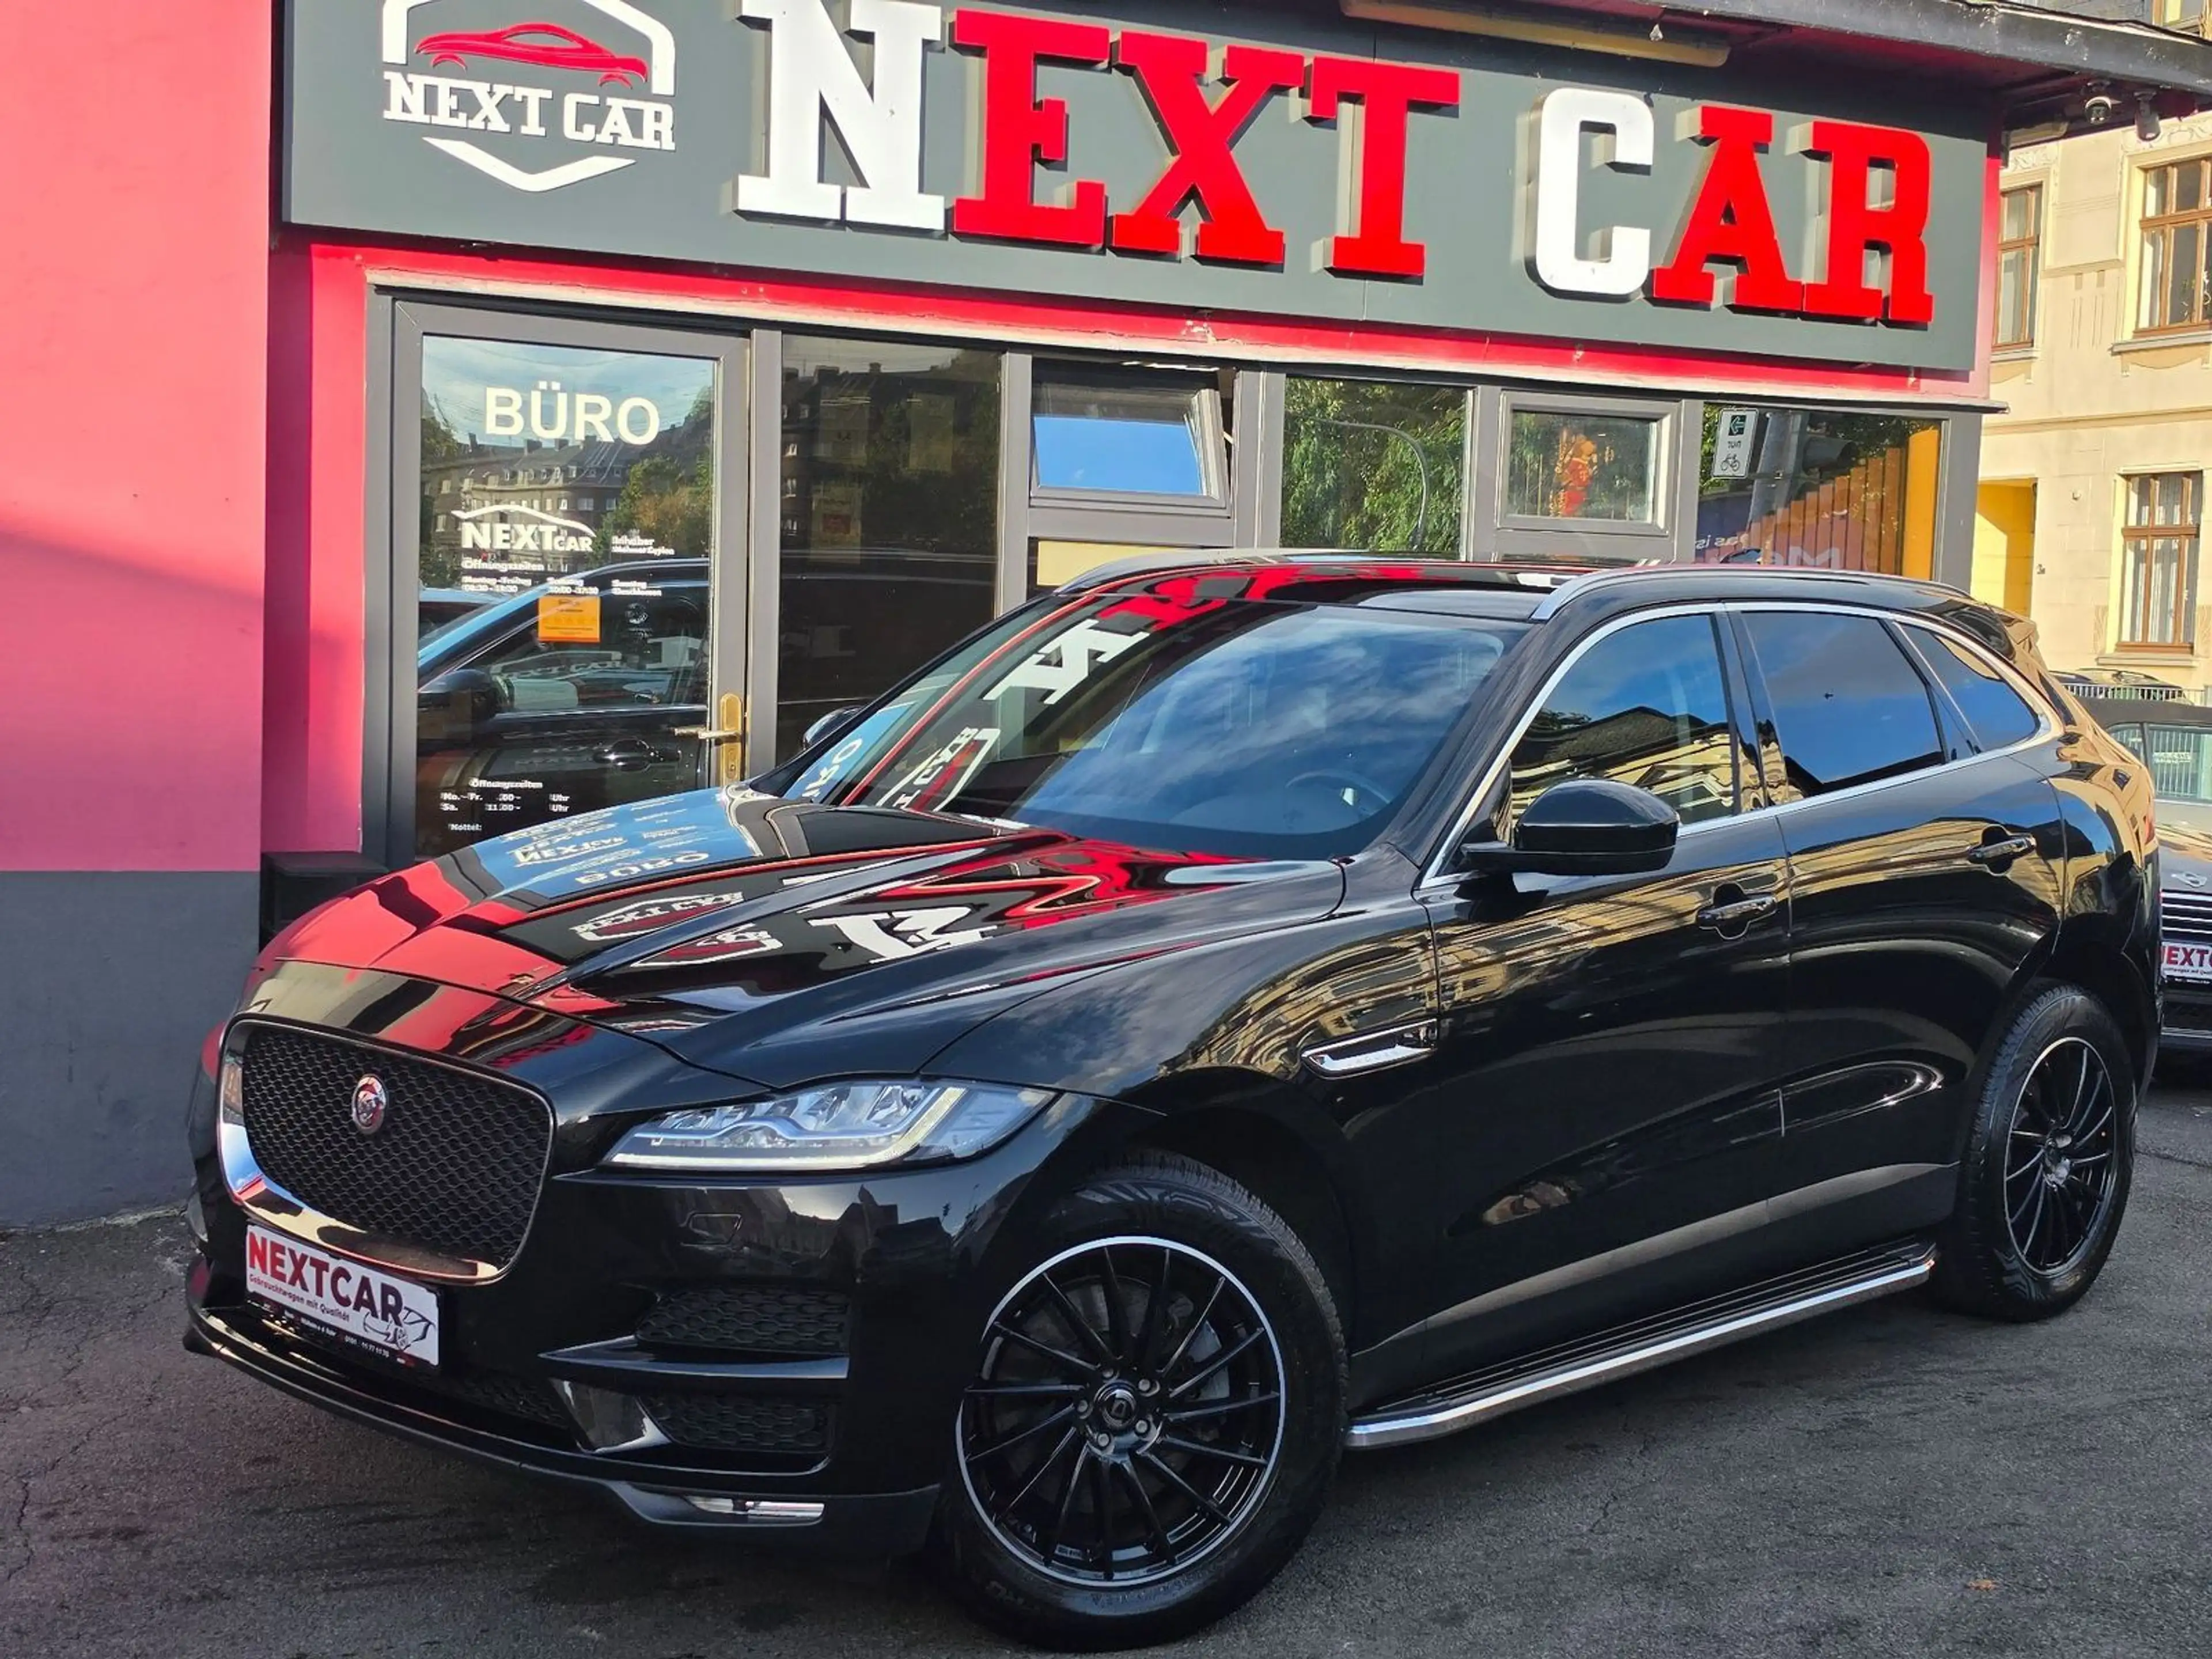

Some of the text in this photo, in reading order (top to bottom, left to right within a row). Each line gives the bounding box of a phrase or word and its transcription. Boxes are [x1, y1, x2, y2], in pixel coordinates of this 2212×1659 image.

[382, 71, 676, 151] NEXT CAR
[737, 0, 1934, 323] NEXT CAR
[486, 380, 660, 445] BÜRO
[249, 1232, 404, 1327] NEXTCAR
